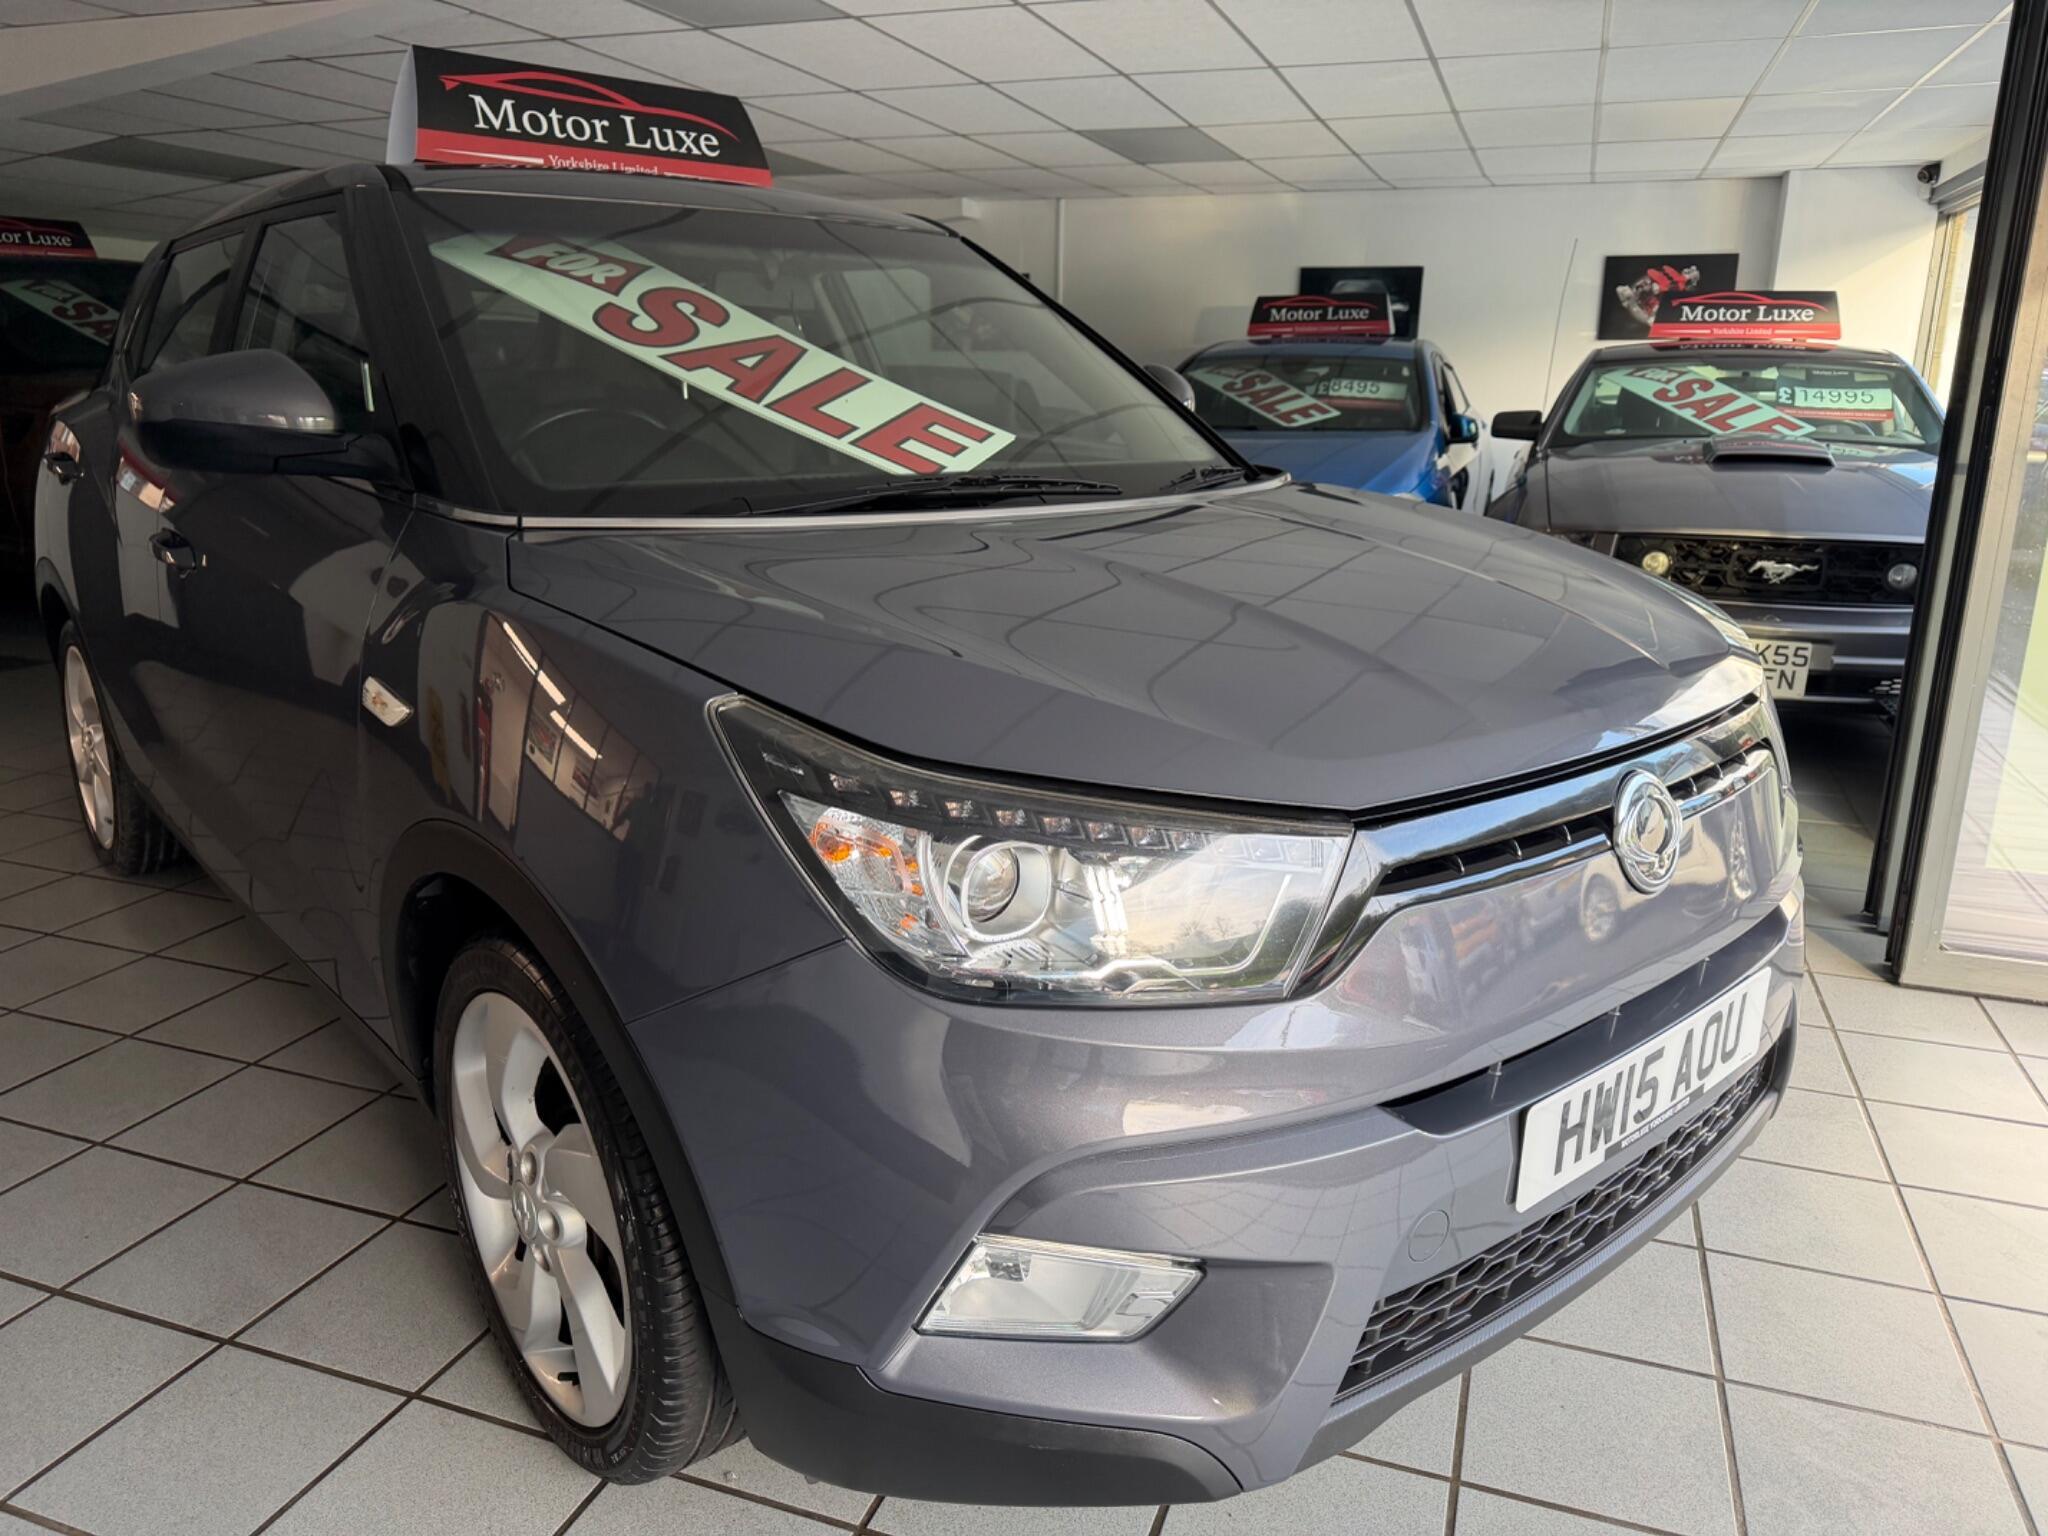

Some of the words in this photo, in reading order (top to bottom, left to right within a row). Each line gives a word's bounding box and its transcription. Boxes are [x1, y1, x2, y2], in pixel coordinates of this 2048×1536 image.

[468, 94, 609, 144] Motor
[620, 114, 720, 158] Luxe
[27, 231, 73, 247] Luxe
[512, 243, 629, 286] FOR
[1269, 306, 1323, 322] Motor
[1326, 306, 1370, 320] Luxe
[1680, 305, 1752, 322] Motor
[1755, 305, 1815, 322] Luxe
[592, 286, 996, 475] SALE
[1221, 373, 1331, 424] SALE
[1778, 386, 1875, 405] £14995
[1554, 1046, 1666, 1176] HW15
[1670, 992, 1749, 1102] AOU
